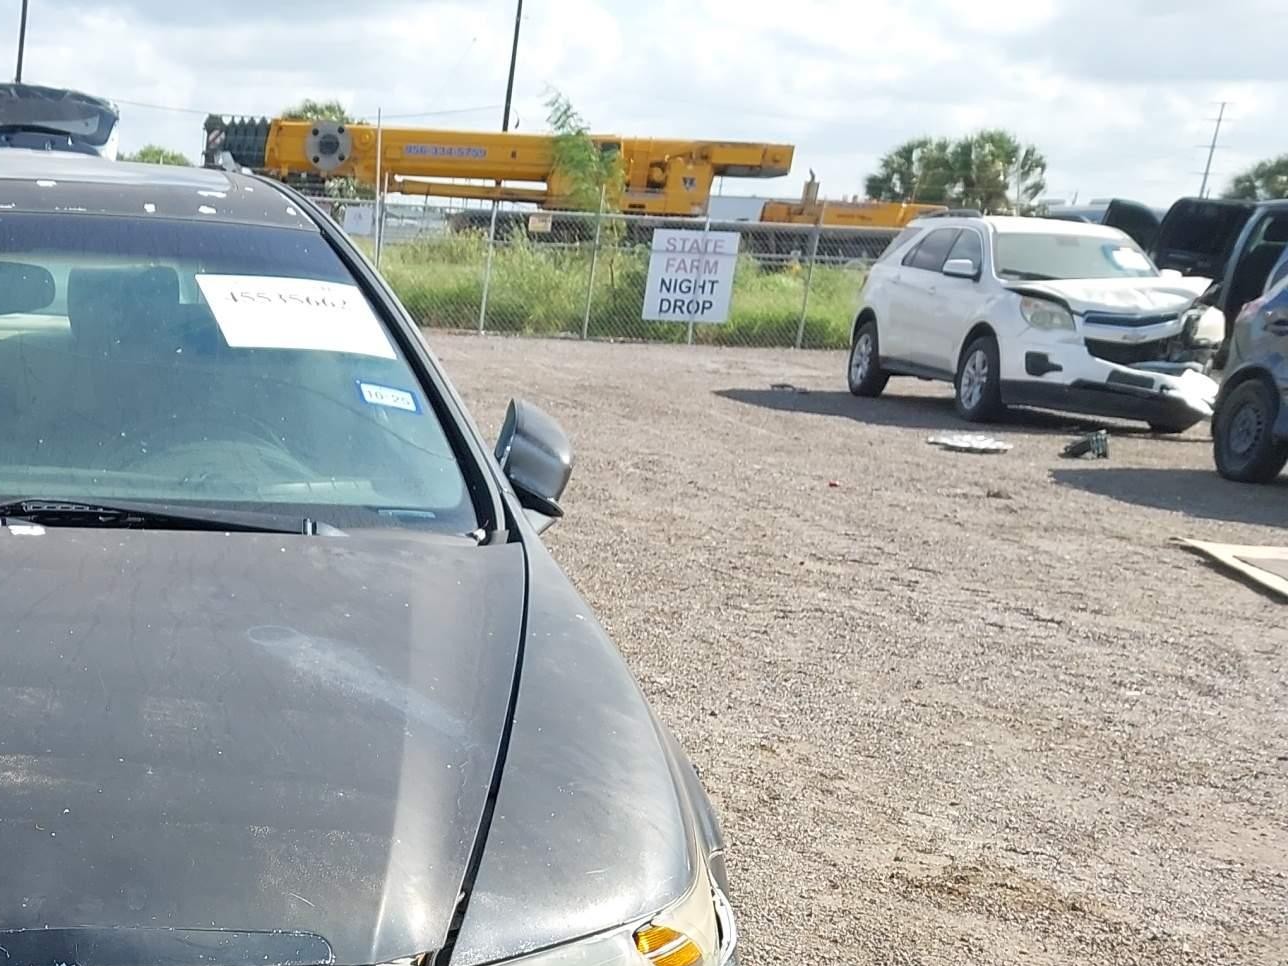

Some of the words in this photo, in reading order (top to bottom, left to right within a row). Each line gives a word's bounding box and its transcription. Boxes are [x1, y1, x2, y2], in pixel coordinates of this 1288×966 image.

[665, 237, 725, 255] STATE
[665, 258, 719, 275] FARM
[659, 277, 719, 295] NIGHT
[659, 297, 713, 315] DROP
